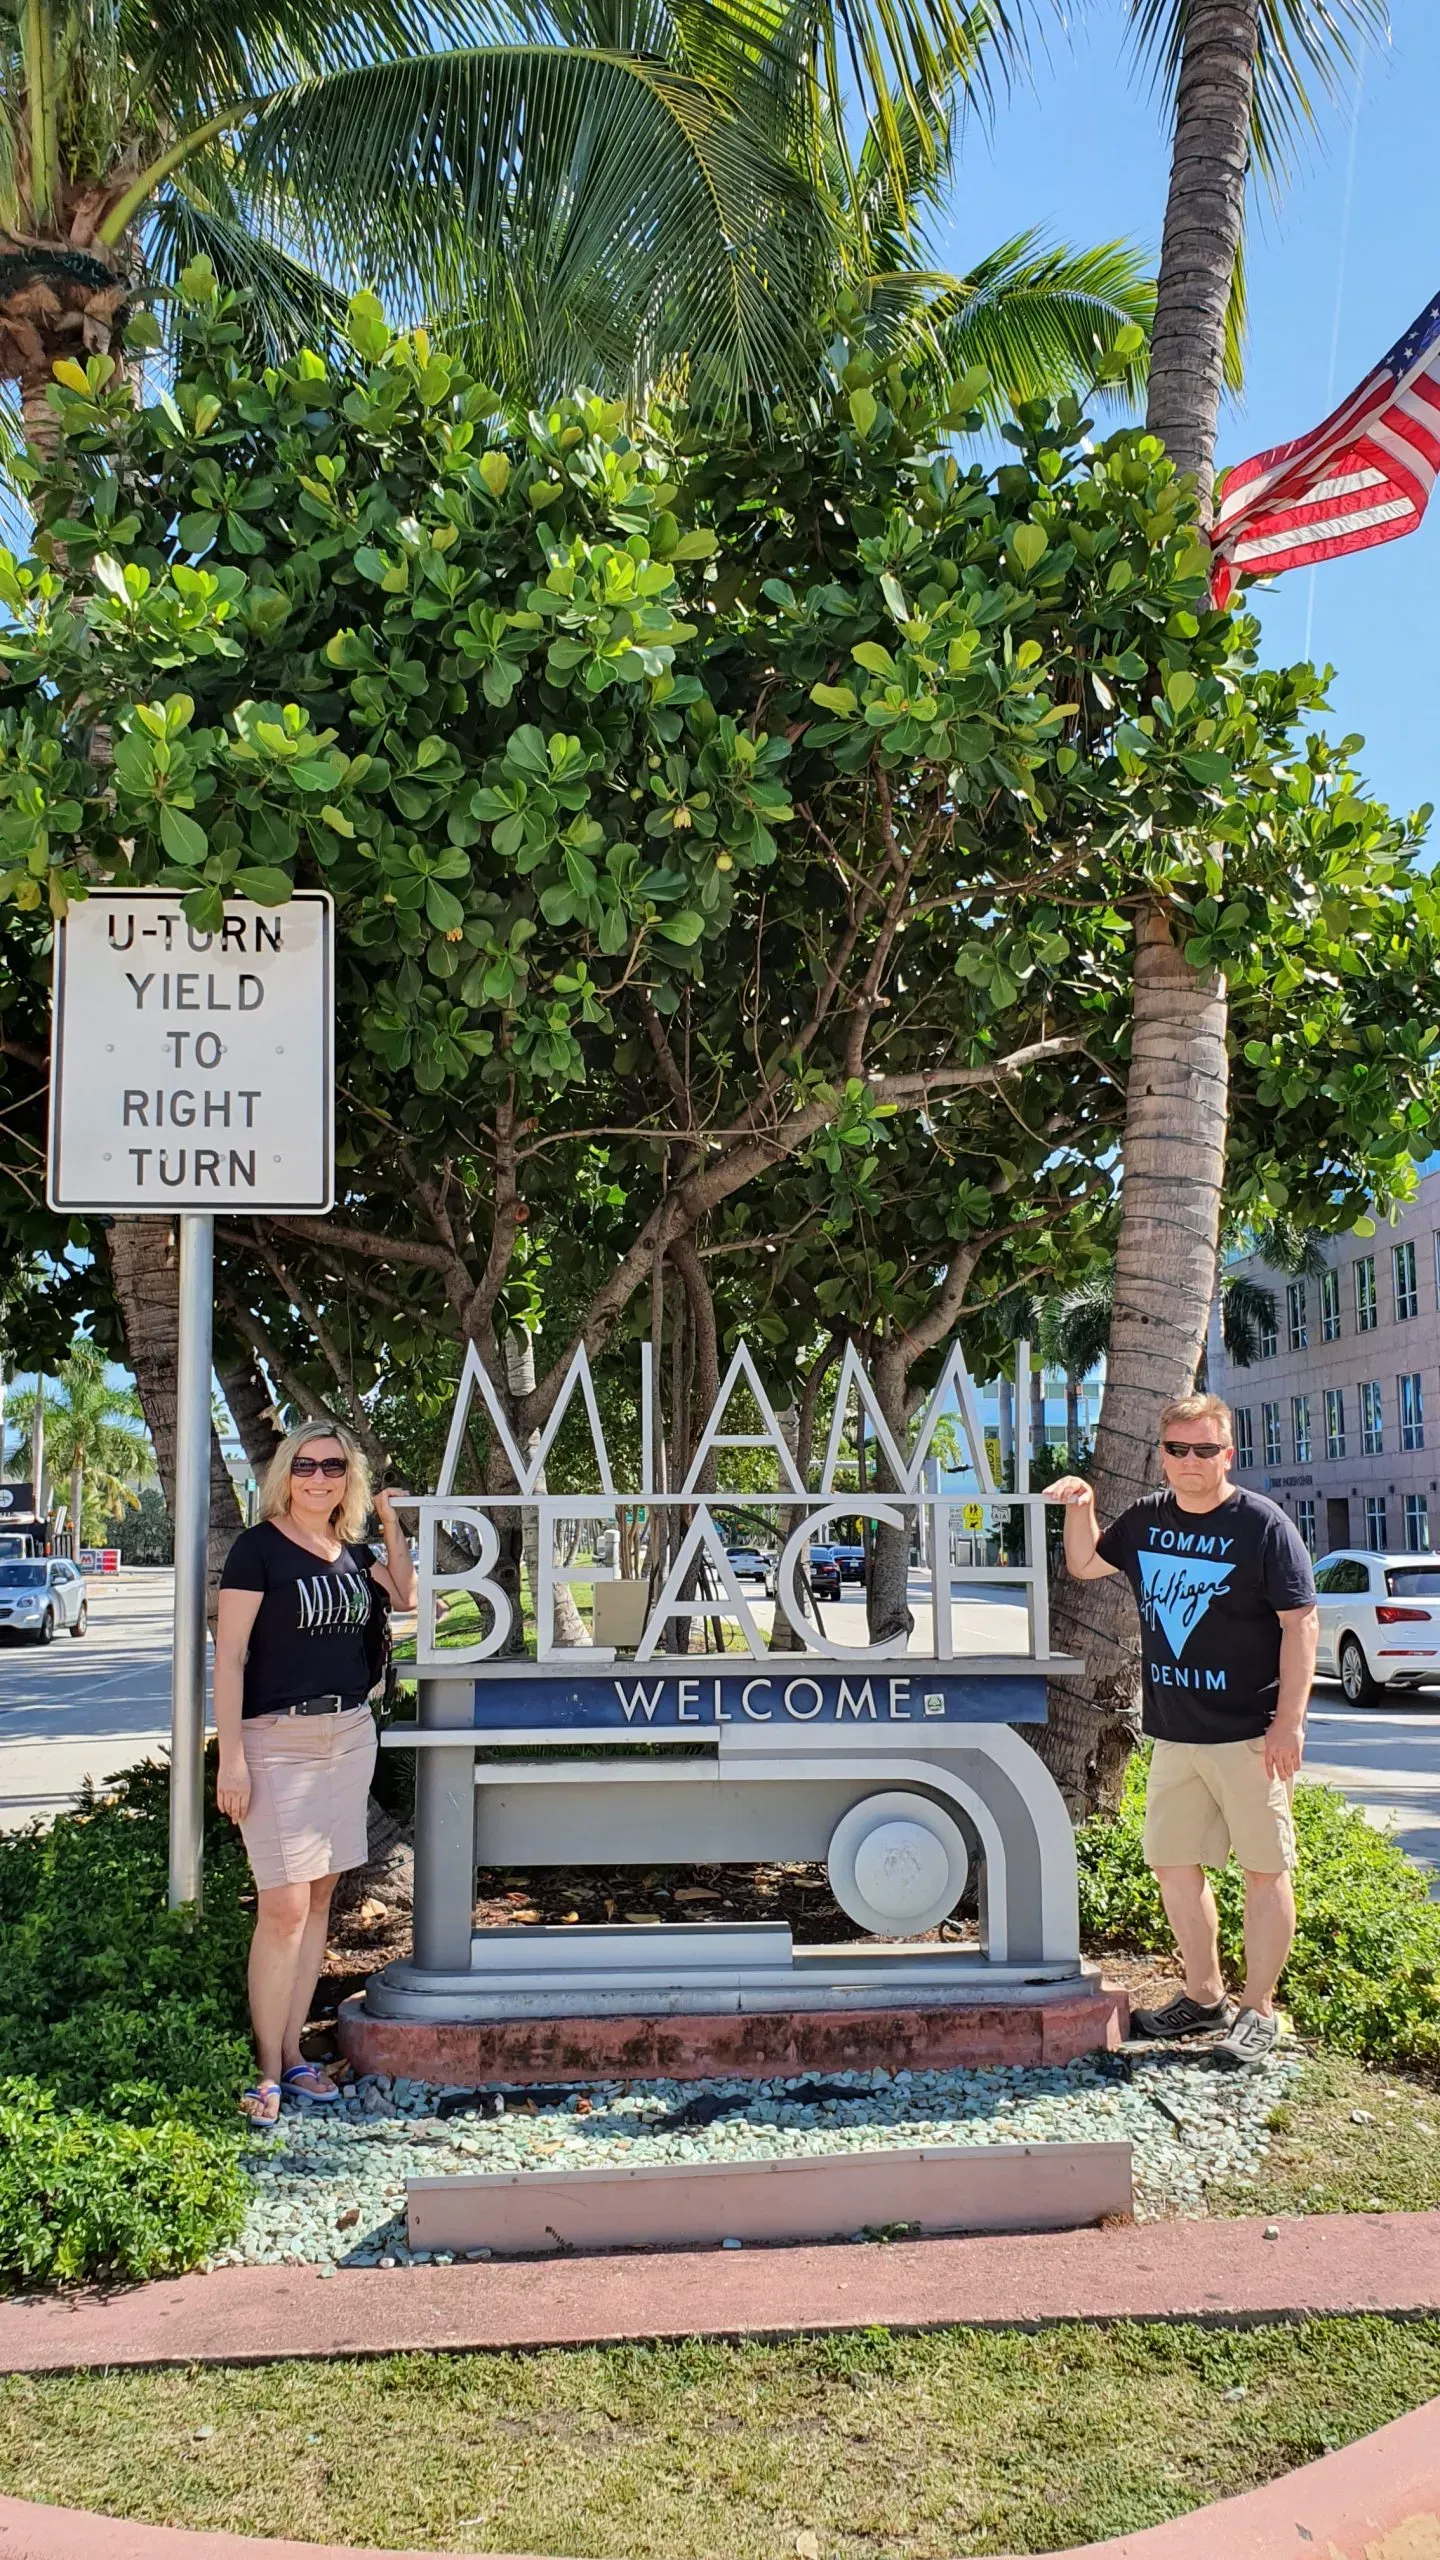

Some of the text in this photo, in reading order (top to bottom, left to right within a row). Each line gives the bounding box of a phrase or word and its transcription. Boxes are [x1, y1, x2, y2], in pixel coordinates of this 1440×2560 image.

[108, 914, 284, 952] U-TURN
[125, 972, 265, 1011] YIELD
[166, 1031, 223, 1069] TO
[123, 1089, 262, 1128] RIGHT
[128, 1148, 256, 1187] TURN
[436, 1338, 1032, 1496] MIAMI
[1148, 1527, 1234, 1556] TOMMY
[416, 1502, 1051, 1664] BEACH
[1141, 1568, 1231, 1632] Hilfiger
[1151, 1662, 1227, 1690] DENIM
[614, 1677, 911, 1723] WELCOME
